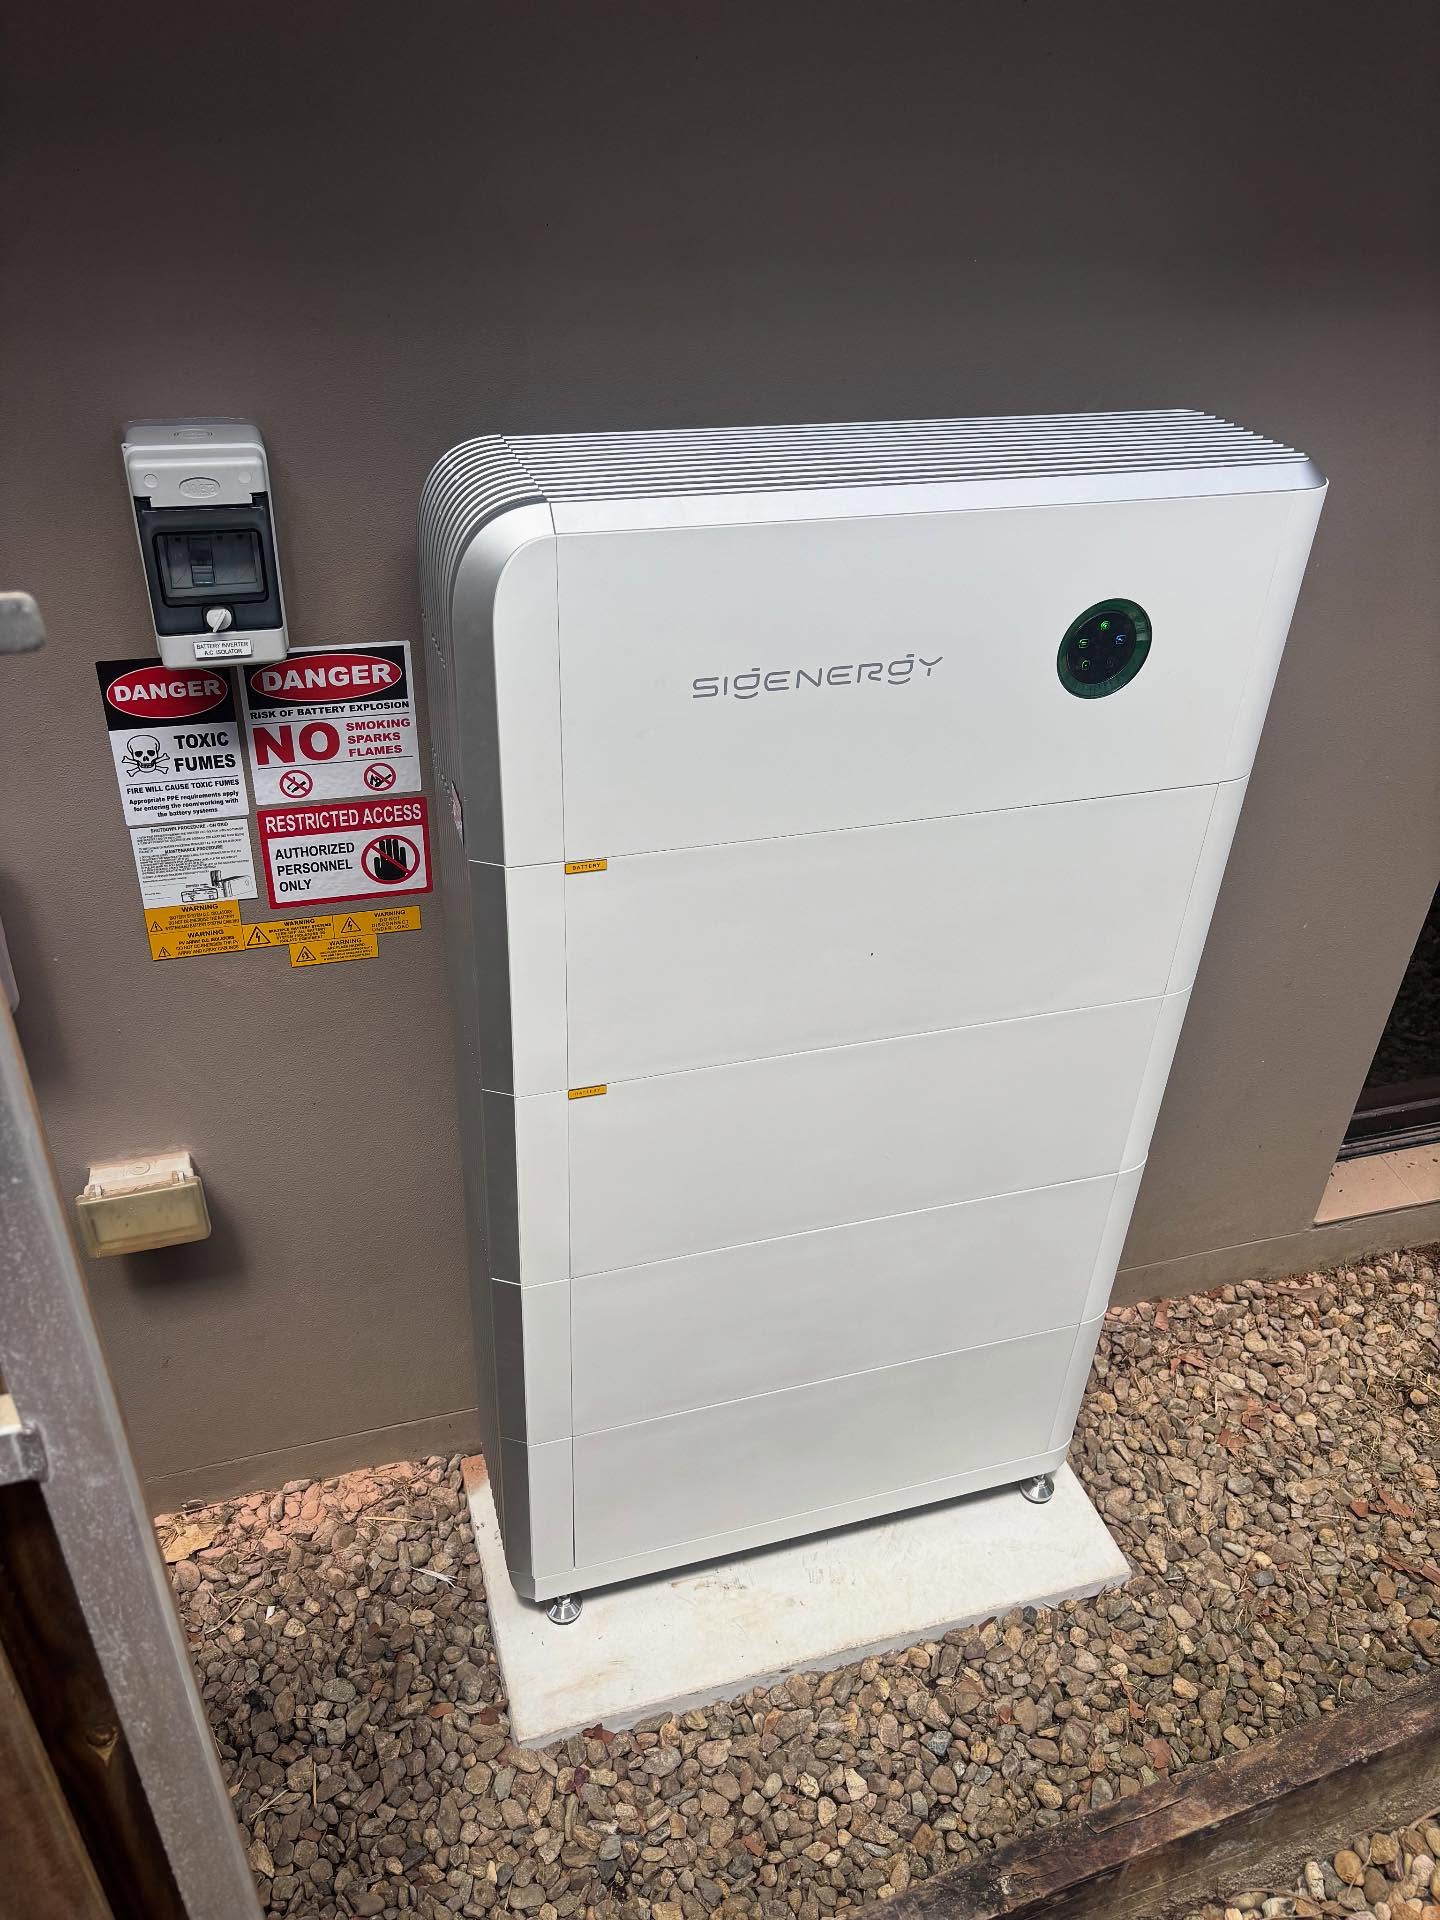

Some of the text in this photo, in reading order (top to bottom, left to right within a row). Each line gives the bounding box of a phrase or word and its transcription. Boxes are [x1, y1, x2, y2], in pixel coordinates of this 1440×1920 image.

[261, 663, 393, 691] DANGER
[692, 653, 943, 700] SIGENERGY
[113, 680, 222, 702] DANGER
[250, 701, 409, 719] RISK OF BATTERY EXPLOSION
[346, 718, 411, 731] SMOKING
[173, 731, 229, 750] TOXIC
[252, 721, 341, 766] NO
[347, 732, 401, 744] SPARKS
[349, 745, 403, 757] FLAMES
[173, 753, 236, 772] FUMES
[127, 787, 144, 795] FIRE
[146, 785, 164, 793] WILL
[165, 783, 189, 792] CAUSE
[214, 779, 240, 787] FUMES
[129, 796, 165, 805] Appropriate
[180, 792, 221, 801] requirements
[144, 803, 170, 812] entering
[169, 808, 191, 817] battery
[192, 806, 218, 815] systems
[265, 803, 422, 833] RESTRICTED ACCESS
[275, 842, 355, 861] AUTHORIZED
[276, 859, 353, 877] PERSONNEL
[572, 863, 601, 871] BATTERY
[279, 879, 312, 892] ONLY
[181, 903, 219, 912] WARNING
[374, 910, 406, 918] WARNING
[284, 918, 315, 926] WARNING
[371, 919, 409, 928] DISCONNECT
[187, 929, 224, 938] WARNING
[329, 937, 362, 946] WARNING
